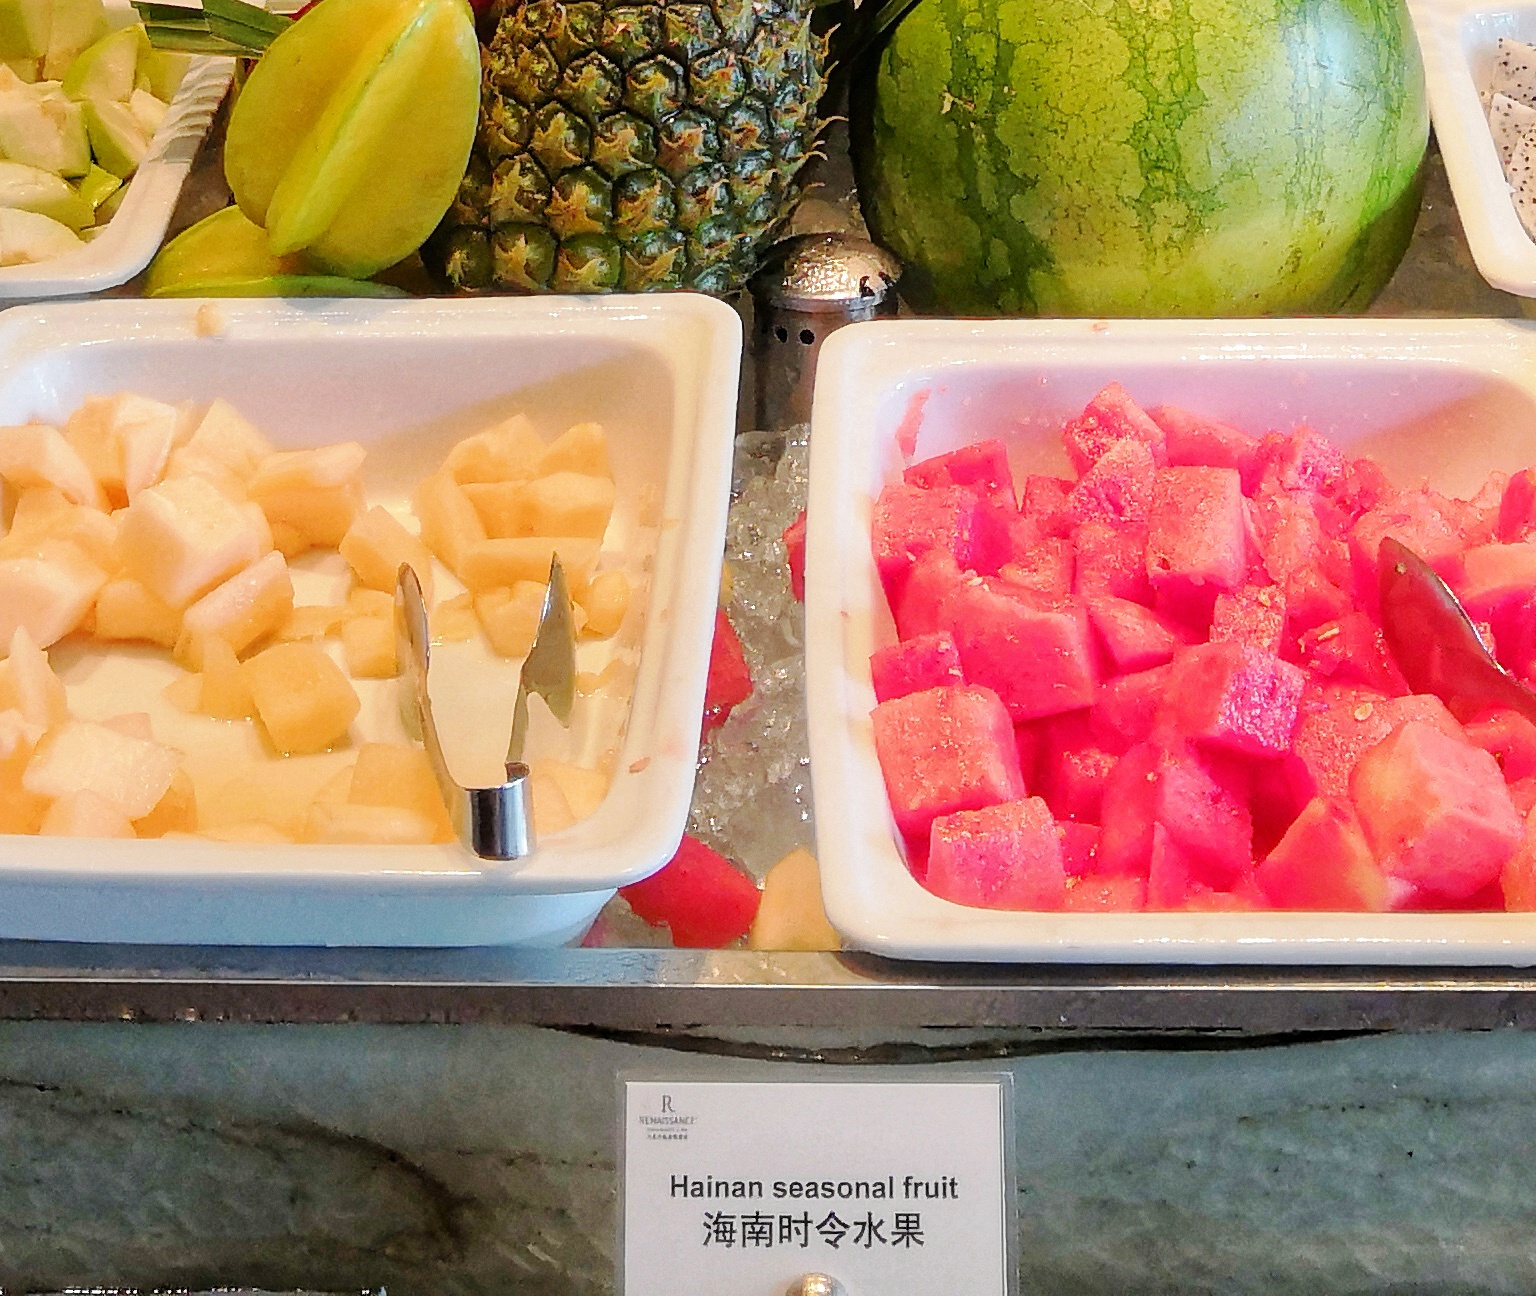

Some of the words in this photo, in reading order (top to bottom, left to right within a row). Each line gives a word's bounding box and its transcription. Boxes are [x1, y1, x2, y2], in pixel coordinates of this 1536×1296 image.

[661, 1094, 676, 1113] R
[670, 1174, 764, 1199] Hainan
[772, 1174, 894, 1199] seasonal
[902, 1174, 960, 1199] fruit
[702, 1210, 925, 1249] 海南时令水果
